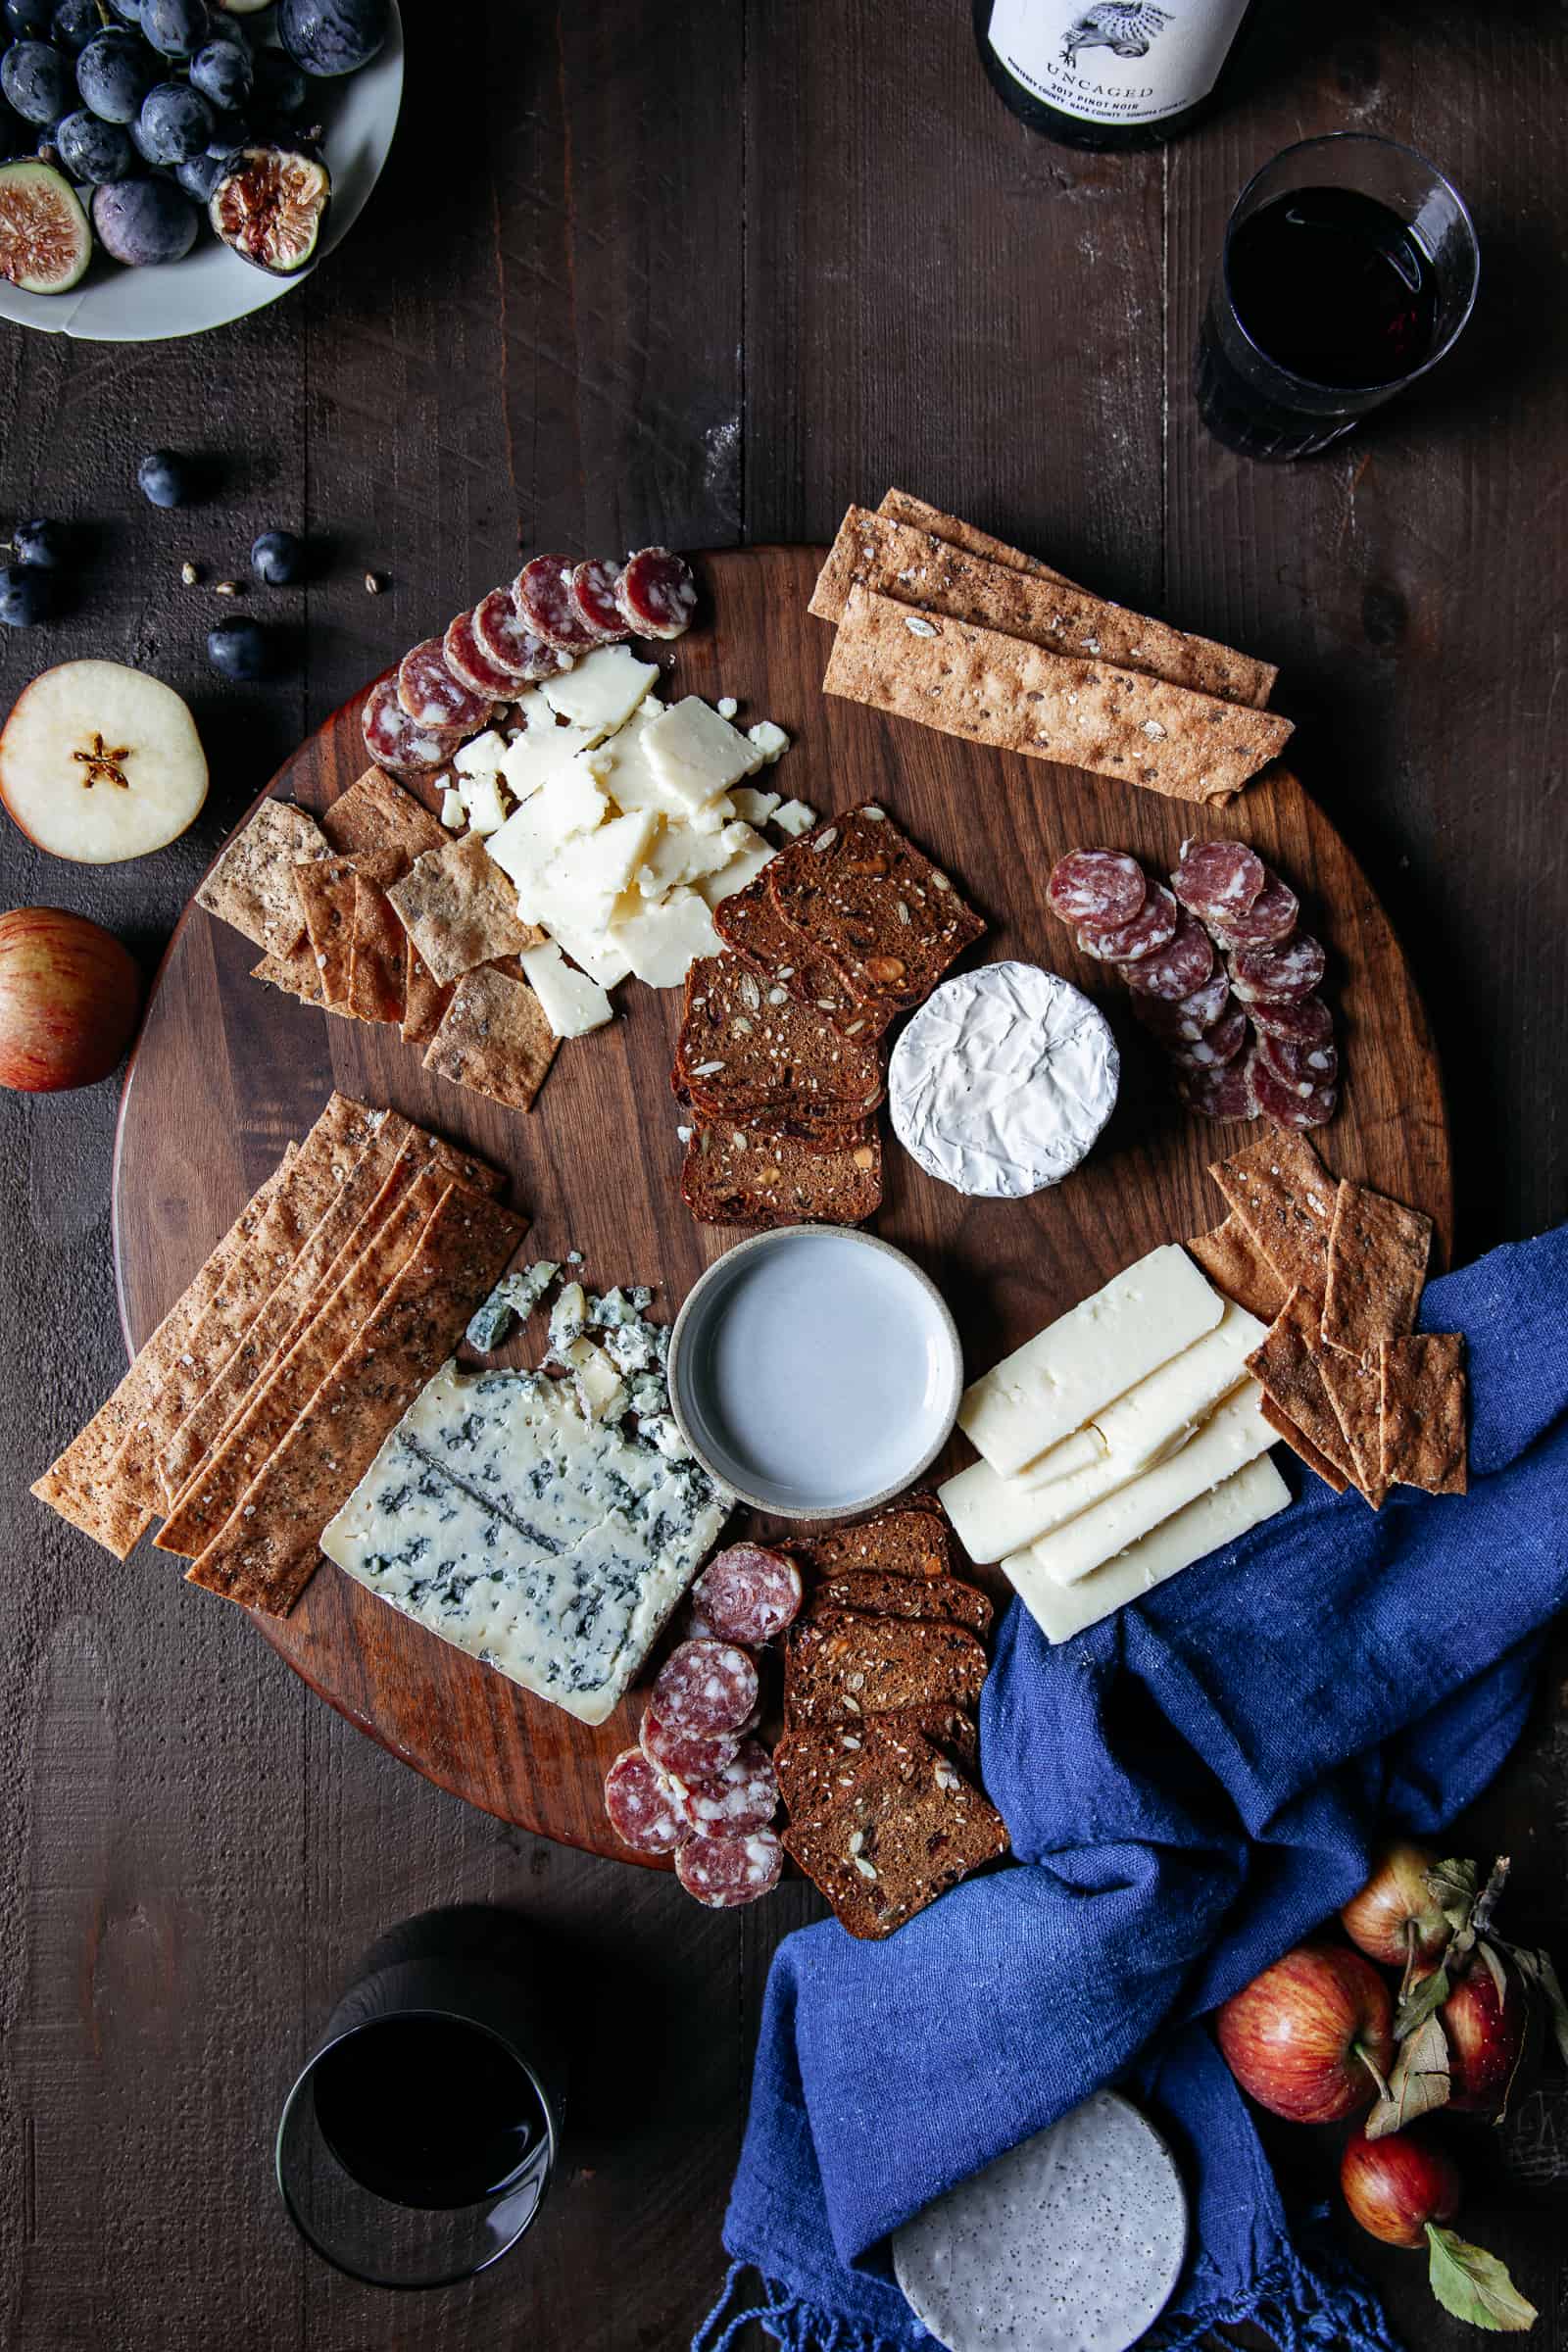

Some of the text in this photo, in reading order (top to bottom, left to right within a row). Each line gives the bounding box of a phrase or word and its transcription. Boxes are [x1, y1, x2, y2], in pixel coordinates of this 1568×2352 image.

[1047, 62, 1153, 98] UNCAGED
[1039, 85, 1065, 103] COUNTY
[1070, 102, 1090, 113] NAPA
[1052, 83, 1139, 111] 2017 PINOT NOIR
